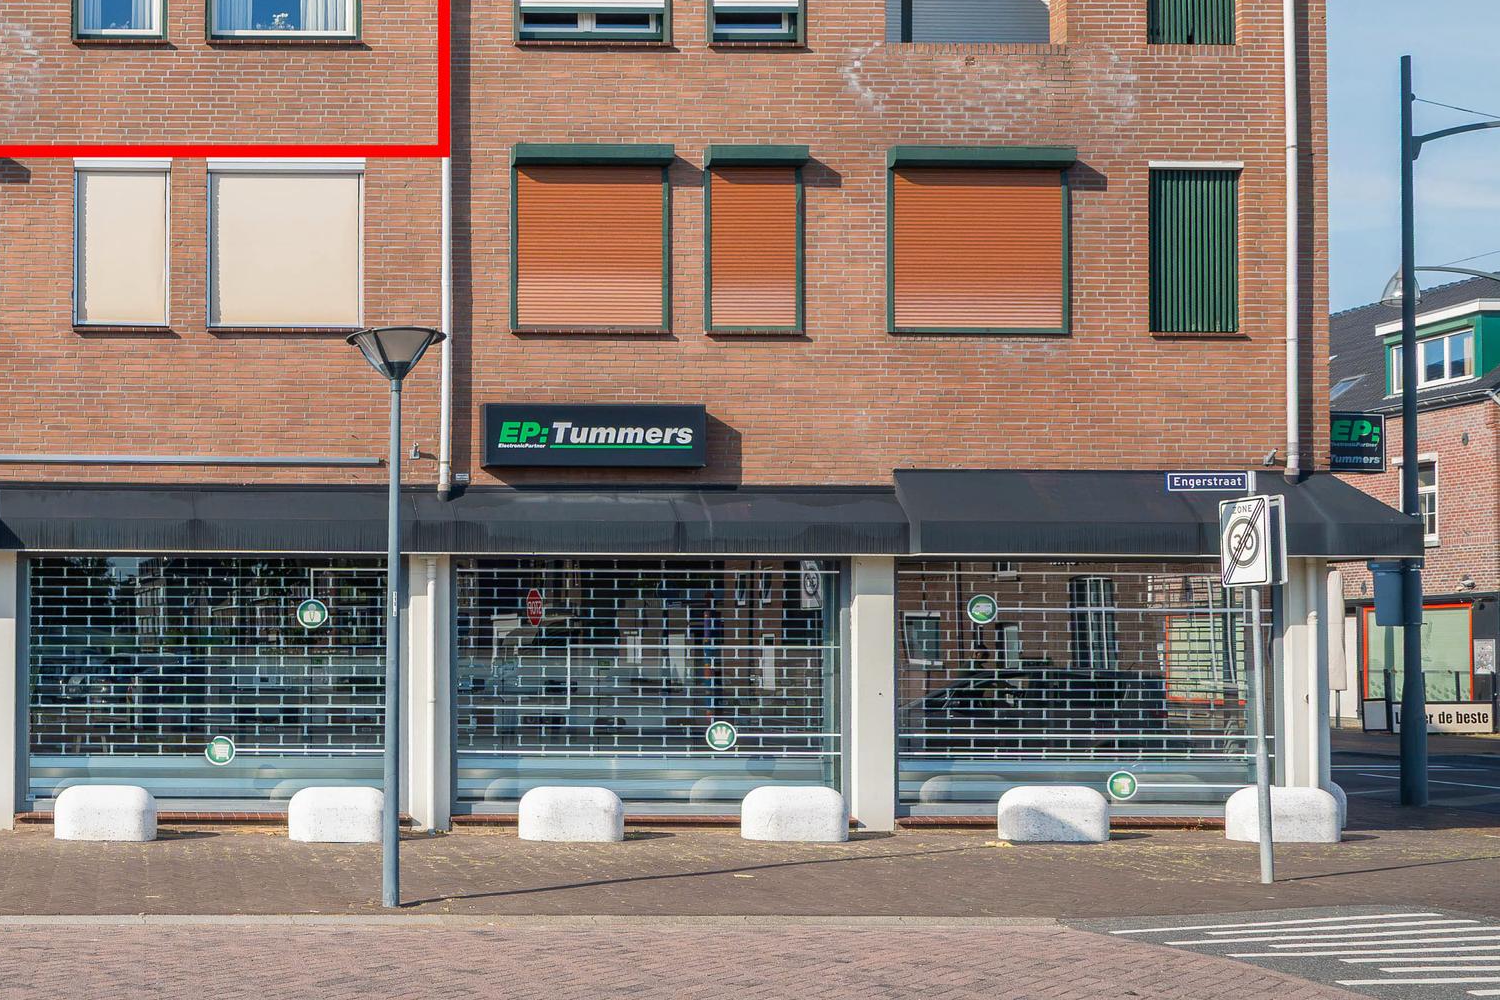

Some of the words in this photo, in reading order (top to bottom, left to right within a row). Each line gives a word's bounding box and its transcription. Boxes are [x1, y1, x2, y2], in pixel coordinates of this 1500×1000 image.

[1174, 477, 1242, 488] Engerstraat
[1232, 504, 1253, 515] ZONE
[1233, 534, 1254, 551] 30
[1438, 711, 1452, 724] de
[1456, 711, 1489, 724] beste
